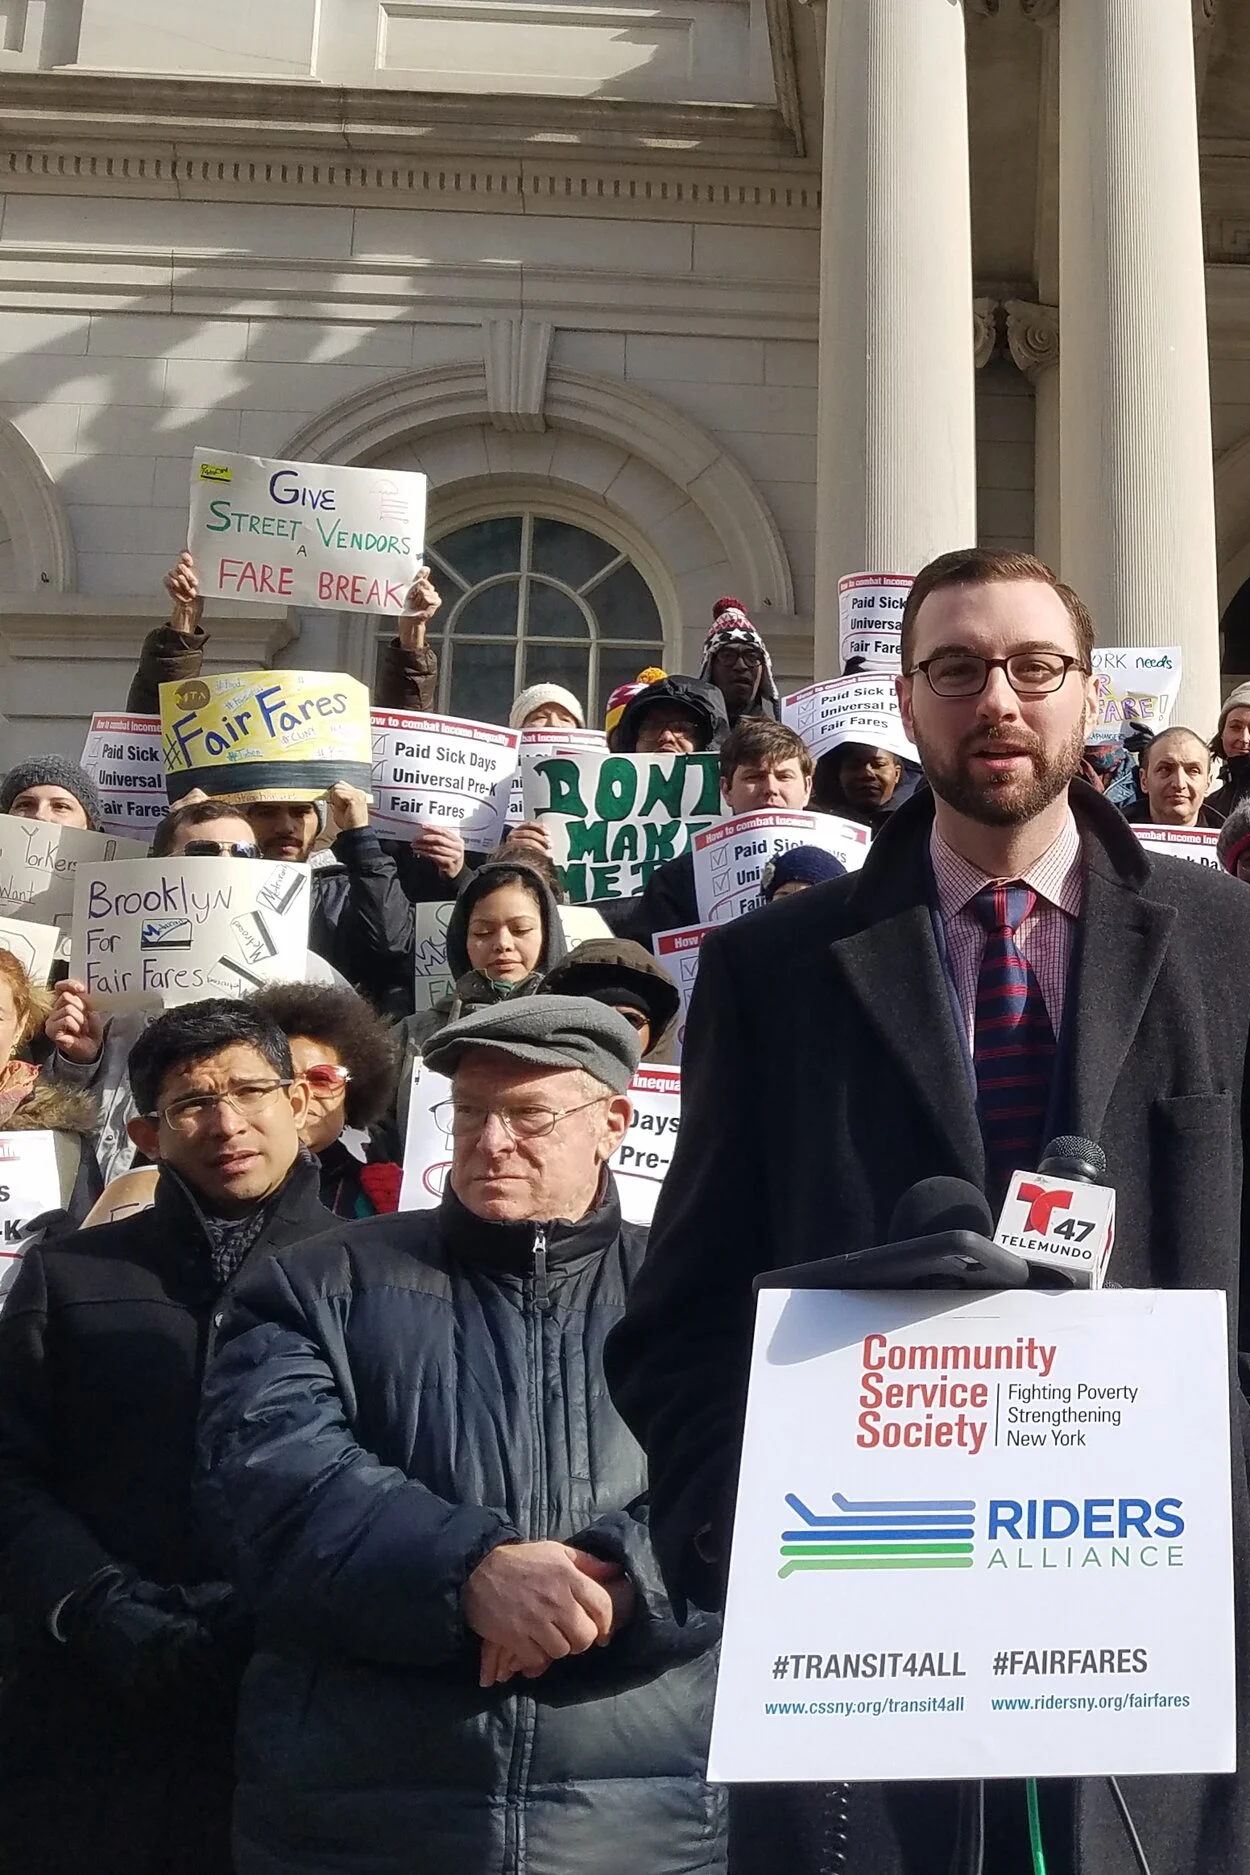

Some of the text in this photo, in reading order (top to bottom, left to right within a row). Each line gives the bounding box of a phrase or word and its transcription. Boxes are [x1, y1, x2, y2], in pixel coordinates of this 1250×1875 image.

[207, 501, 411, 555] STREET VENDORS
[297, 545, 307, 557] A
[219, 559, 404, 608] FARE BREAK
[852, 596, 906, 609] Paid Sick
[851, 617, 901, 630] Universa
[850, 640, 901, 654] Fair Fare
[1091, 653, 1172, 669] ORK needs
[821, 688, 884, 705] Paid Sick
[821, 702, 884, 718] Universal
[388, 716, 399, 727] to
[401, 719, 439, 731] combat
[821, 717, 888, 734] Fair Fares
[102, 744, 159, 761] Paid Sick
[395, 742, 496, 772] Paid Sick Days
[99, 770, 162, 788] Universal
[393, 768, 498, 796] Universal Pre-K
[101, 800, 169, 817] air Fares
[390, 796, 465, 818] Fair Fares
[706, 815, 775, 843] How to combat
[735, 840, 767, 861] Paid
[86, 929, 121, 955] For
[675, 936, 699, 949] How
[86, 959, 204, 995] Fair Fares
[632, 1073, 680, 1092] inequa
[619, 1145, 669, 1169] Pre-
[1053, 1218, 1096, 1243] 47
[1000, 1234, 1092, 1260] TELEMUNDO
[863, 1334, 1057, 1377] Community
[859, 1375, 988, 1409] Service
[1008, 1383, 1138, 1403] Fighting Poverty
[1008, 1406, 1121, 1426] Strengthening
[856, 1410, 987, 1455] Society
[1007, 1429, 1086, 1447] New York
[988, 1498, 1186, 1541] RIDERS
[987, 1545, 1185, 1569] ALLIANCE
[772, 1648, 1148, 1680] #TRANSIT4ALL #FAIRFARES
[764, 1692, 1191, 1717] www.cssny.org/transit4all www.ridersny.org/fairfares
